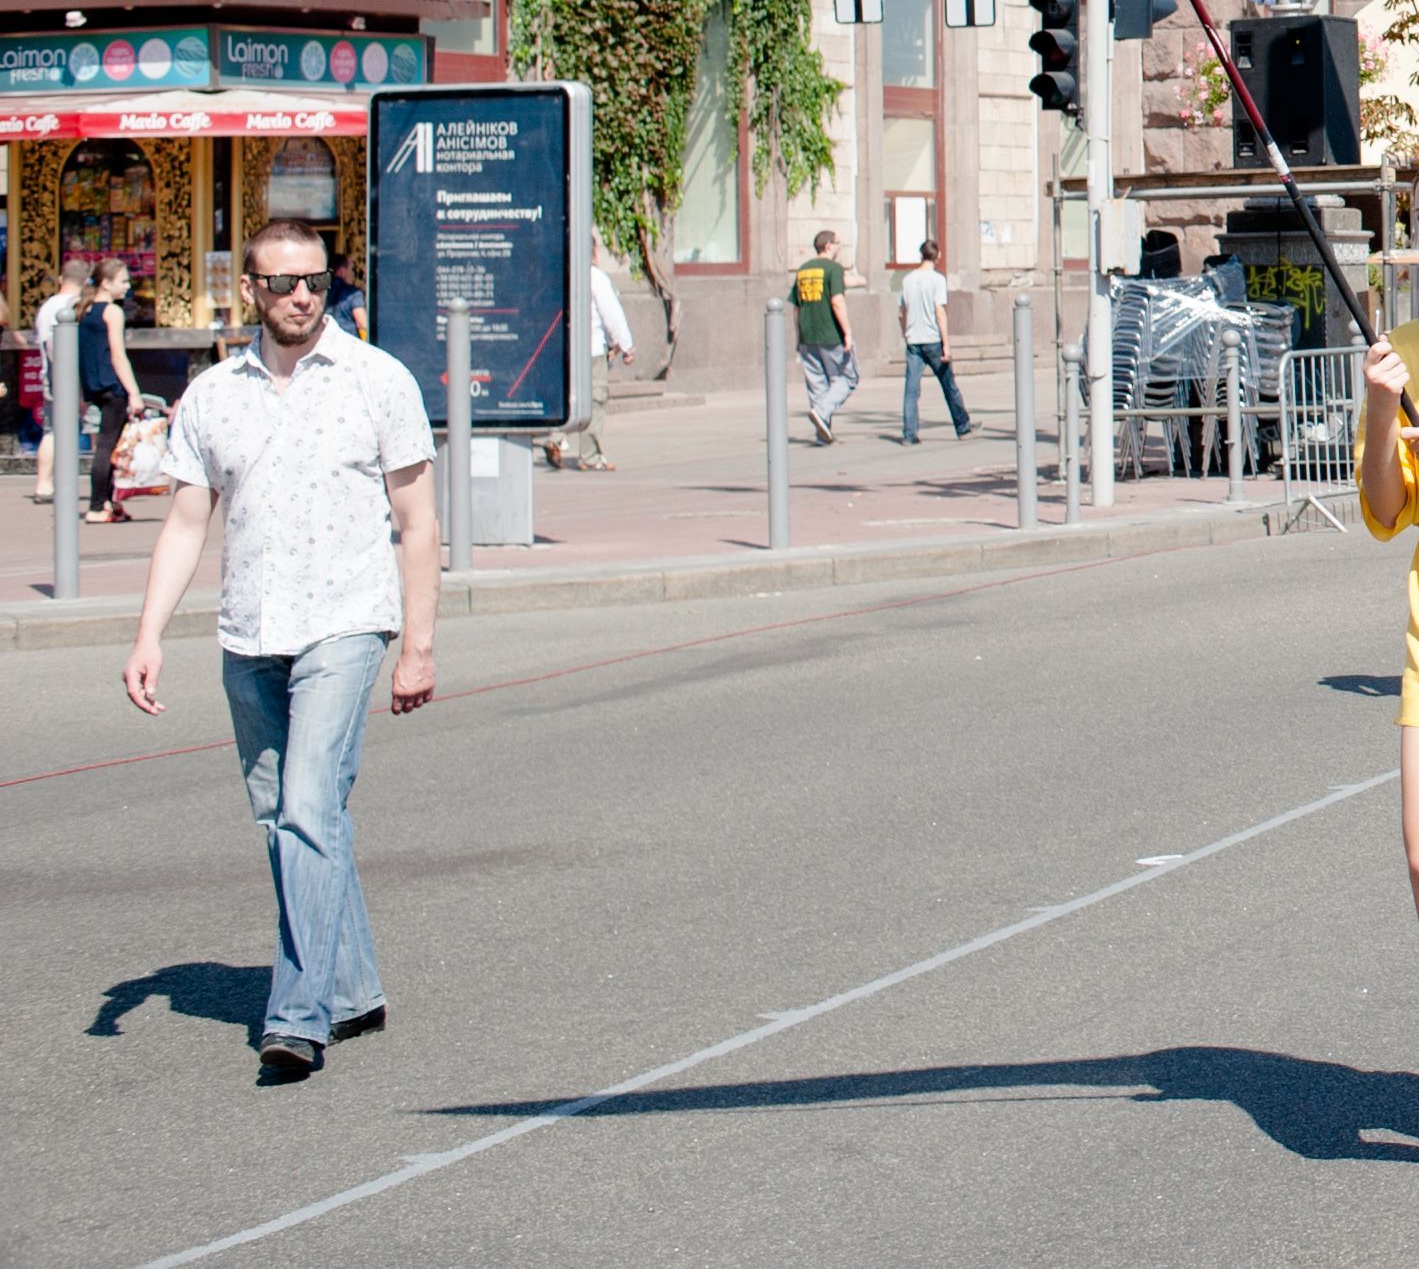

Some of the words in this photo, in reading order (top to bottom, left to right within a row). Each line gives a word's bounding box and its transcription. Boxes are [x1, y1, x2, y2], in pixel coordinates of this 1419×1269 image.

[0, 46, 67, 69] aimon
[227, 34, 288, 64] Laimon
[119, 113, 168, 131] Mario
[246, 113, 292, 130] Mario
[436, 120, 518, 137] АЛЕЙНІКОВ
[436, 137, 508, 150] АНІСІМОВ
[436, 162, 483, 175] контора
